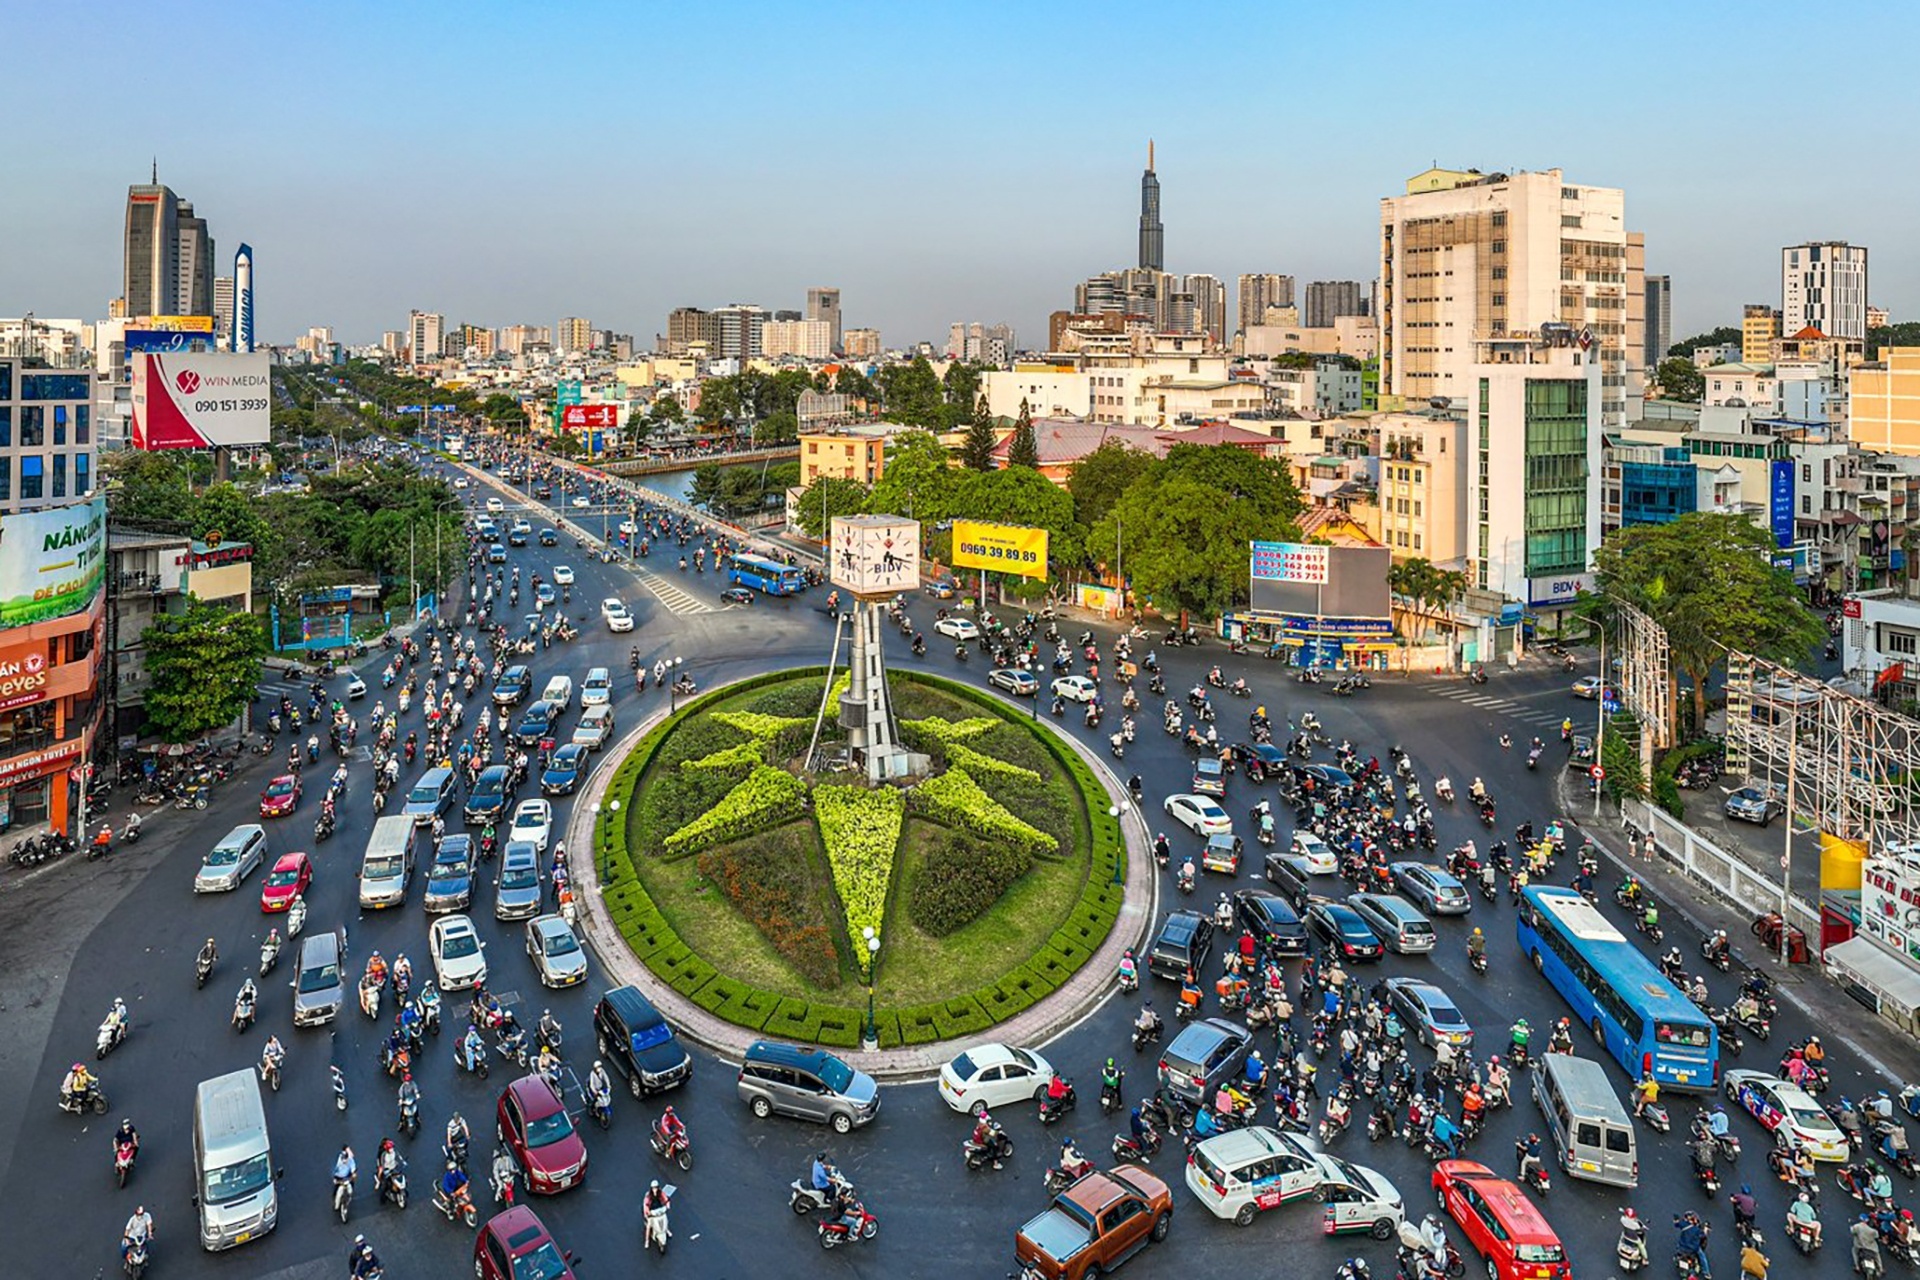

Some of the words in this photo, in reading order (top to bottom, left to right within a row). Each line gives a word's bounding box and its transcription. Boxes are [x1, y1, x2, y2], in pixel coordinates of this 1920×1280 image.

[204, 376, 230, 387] WIN
[231, 375, 268, 387] MEDIA
[195, 400, 218, 413] 090
[219, 399, 237, 412] 151
[240, 398, 268, 411] 3939
[960, 542, 1037, 563] 0969.39.89.89
[874, 562, 903, 574] BIDV
[1552, 580, 1575, 594] BIDV
[16, 754, 42, 769] NGON
